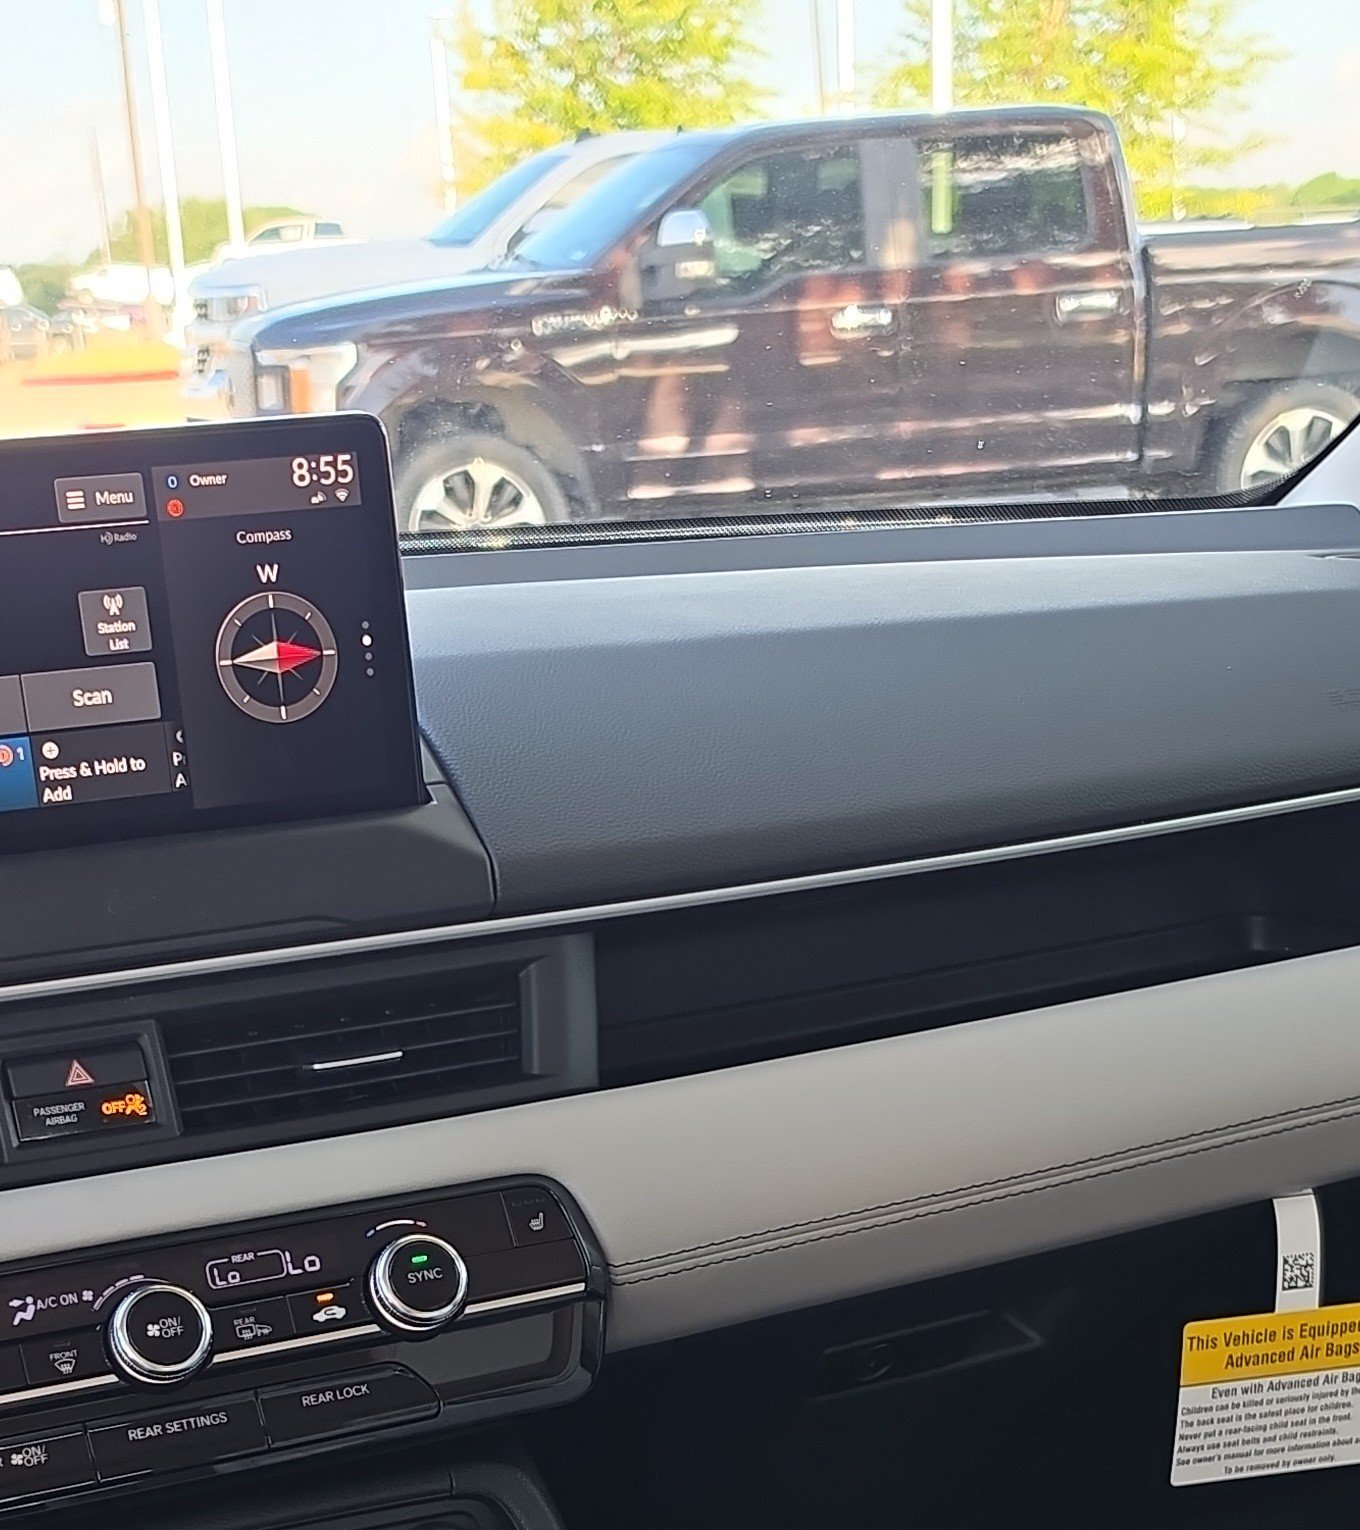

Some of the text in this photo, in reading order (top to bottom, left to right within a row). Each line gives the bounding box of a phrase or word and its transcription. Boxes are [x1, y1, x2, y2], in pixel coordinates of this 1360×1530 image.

[292, 454, 354, 487] 8:55
[190, 473, 227, 487] Owner
[95, 491, 134, 505] Menu
[114, 532, 137, 542] Radio
[236, 529, 292, 545] Compass
[256, 563, 279, 583] W
[97, 619, 136, 635] Station
[109, 637, 129, 651] List
[73, 688, 112, 707] Scan
[40, 757, 146, 781] Press & Hold to
[43, 785, 72, 803] Add
[33, 1101, 127, 1117] PASSENGER OFF
[45, 1114, 78, 1126] AIRBAG
[231, 1252, 255, 1264] REAR
[284, 1250, 321, 1275] Lo
[213, 1267, 241, 1286] Lo
[407, 1267, 443, 1284] SYNC
[36, 1292, 78, 1310] A/C ON
[159, 1316, 181, 1329] ON/
[233, 1316, 255, 1327] REAR
[161, 1326, 184, 1339] OFF
[1187, 1335, 1218, 1351] This
[1223, 1329, 1277, 1347] Vehicle
[1282, 1326, 1294, 1340] is
[49, 1349, 78, 1361] FRONT
[1224, 1340, 1360, 1370] Advanced Air Bags
[302, 1383, 370, 1407] REAR LOCK
[1211, 1386, 1237, 1399] Even
[1240, 1382, 1264, 1396] with
[1266, 1376, 1320, 1393] Advanced
[1322, 1373, 1339, 1385] Air
[1181, 1405, 1214, 1416] Children
[1215, 1403, 1229, 1412] can
[1231, 1400, 1241, 1409] be
[1242, 1398, 1264, 1408] killed
[1275, 1393, 1310, 1405] seriously
[1311, 1389, 1338, 1400] injured
[1340, 1387, 1349, 1397] by
[1180, 1400, 1353, 1428] The back seat the safest place for children.
[128, 1411, 228, 1441] REAR SETTINGS
[1179, 1432, 1201, 1441] Never
[1203, 1429, 1216, 1439] put
[1224, 1423, 1267, 1435] rear-facing
[1269, 1419, 1288, 1430] child
[1290, 1418, 1307, 1427] seat
[1318, 1415, 1330, 1424] the
[21, 1444, 47, 1458] ON/
[1177, 1443, 1205, 1454] Always
[1206, 1442, 1220, 1450] use
[1223, 1438, 1239, 1448] seat
[1241, 1435, 1260, 1445] belts
[1262, 1434, 1277, 1443] and
[1278, 1431, 1298, 1441] child
[24, 1453, 49, 1467] OFF
[1176, 1458, 1190, 1467] See
[1192, 1453, 1221, 1464] owner's
[1223, 1449, 1252, 1460] manual
[1253, 1448, 1264, 1456] for
[1266, 1446, 1285, 1455] more
[1287, 1440, 1330, 1452] information
[1332, 1437, 1353, 1447] about
[1234, 1455, 1316, 1473] be removed by owner
